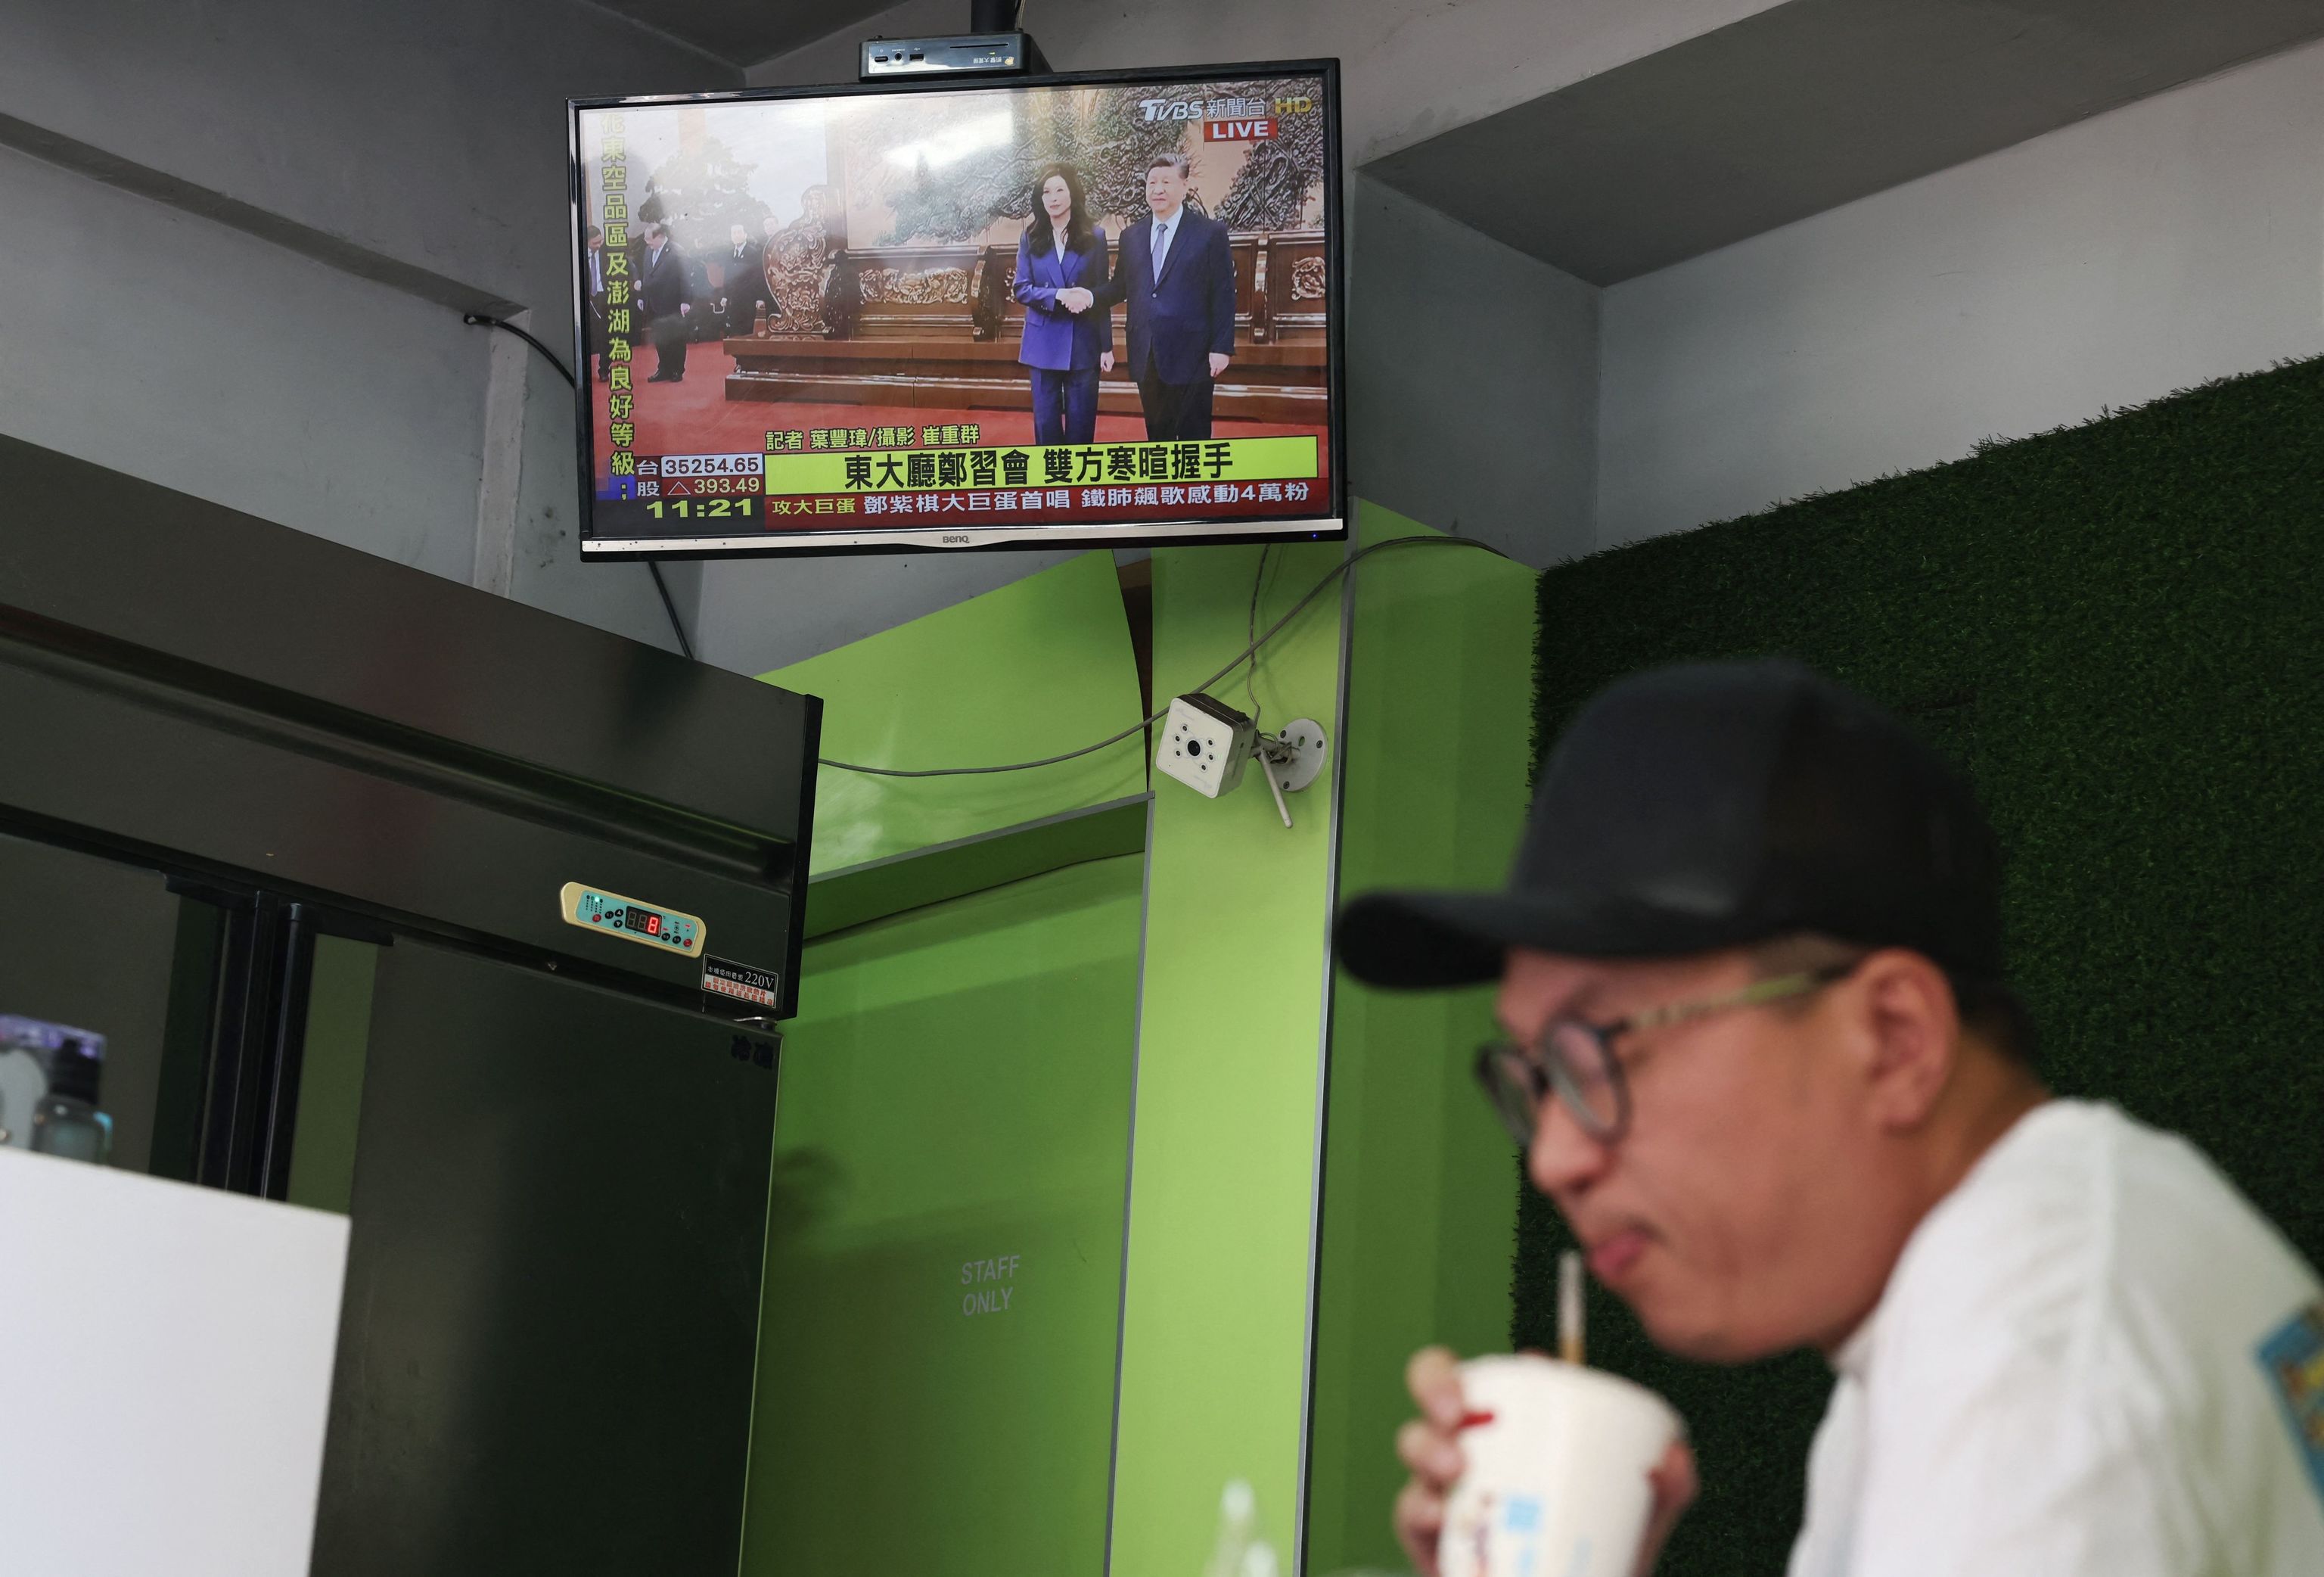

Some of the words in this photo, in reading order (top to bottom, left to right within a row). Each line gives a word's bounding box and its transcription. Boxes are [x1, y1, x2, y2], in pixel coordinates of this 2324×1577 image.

[1139, 98, 1204, 121] TVBS
[1207, 98, 1266, 117] 新聞台
[1275, 97, 1313, 114] HD
[1213, 121, 1269, 138] LIVE
[766, 431, 803, 450] 記者
[921, 425, 979, 445] 崔重群
[665, 458, 759, 474] 35254.65
[844, 449, 1030, 490] 東大廳鄭習會
[1043, 442, 1233, 484] 雙方寒暄握手
[694, 477, 760, 494] 393.49
[646, 499, 751, 518] 11:21
[772, 498, 856, 515] 攻大巨蛋
[864, 490, 1070, 515] 鄧紫棋大巨蛋首唱
[1081, 482, 1309, 508] 鐵肺飆歌感動4萬粉
[648, 916, 659, 935] 8
[744, 972, 774, 989] 220V
[961, 1255, 1020, 1285] STAFF
[963, 1287, 1013, 1316] ONLY
